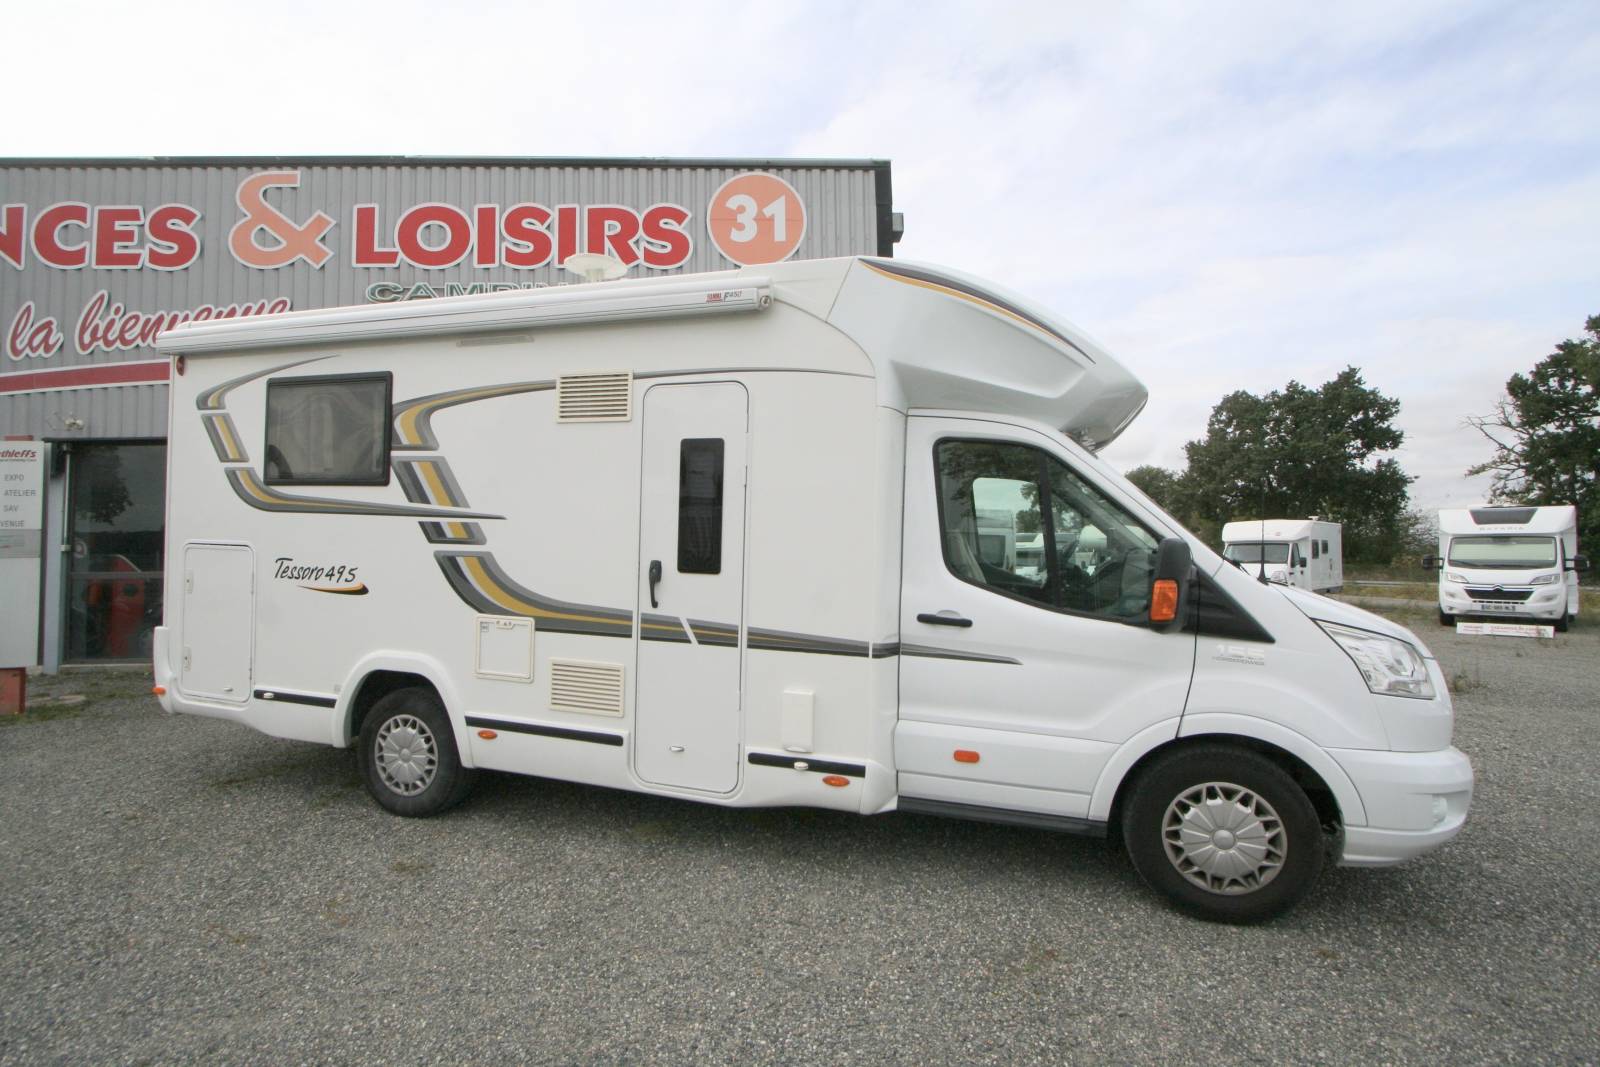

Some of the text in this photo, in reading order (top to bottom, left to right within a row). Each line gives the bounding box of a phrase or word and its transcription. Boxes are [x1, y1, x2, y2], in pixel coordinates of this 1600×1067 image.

[228, 170, 337, 270] &
[351, 202, 694, 271] LOISIRS
[727, 194, 787, 242] 31
[7, 301, 63, 360] la
[4, 489, 36, 497] ATELIER
[274, 557, 359, 583] Tessoro 495
